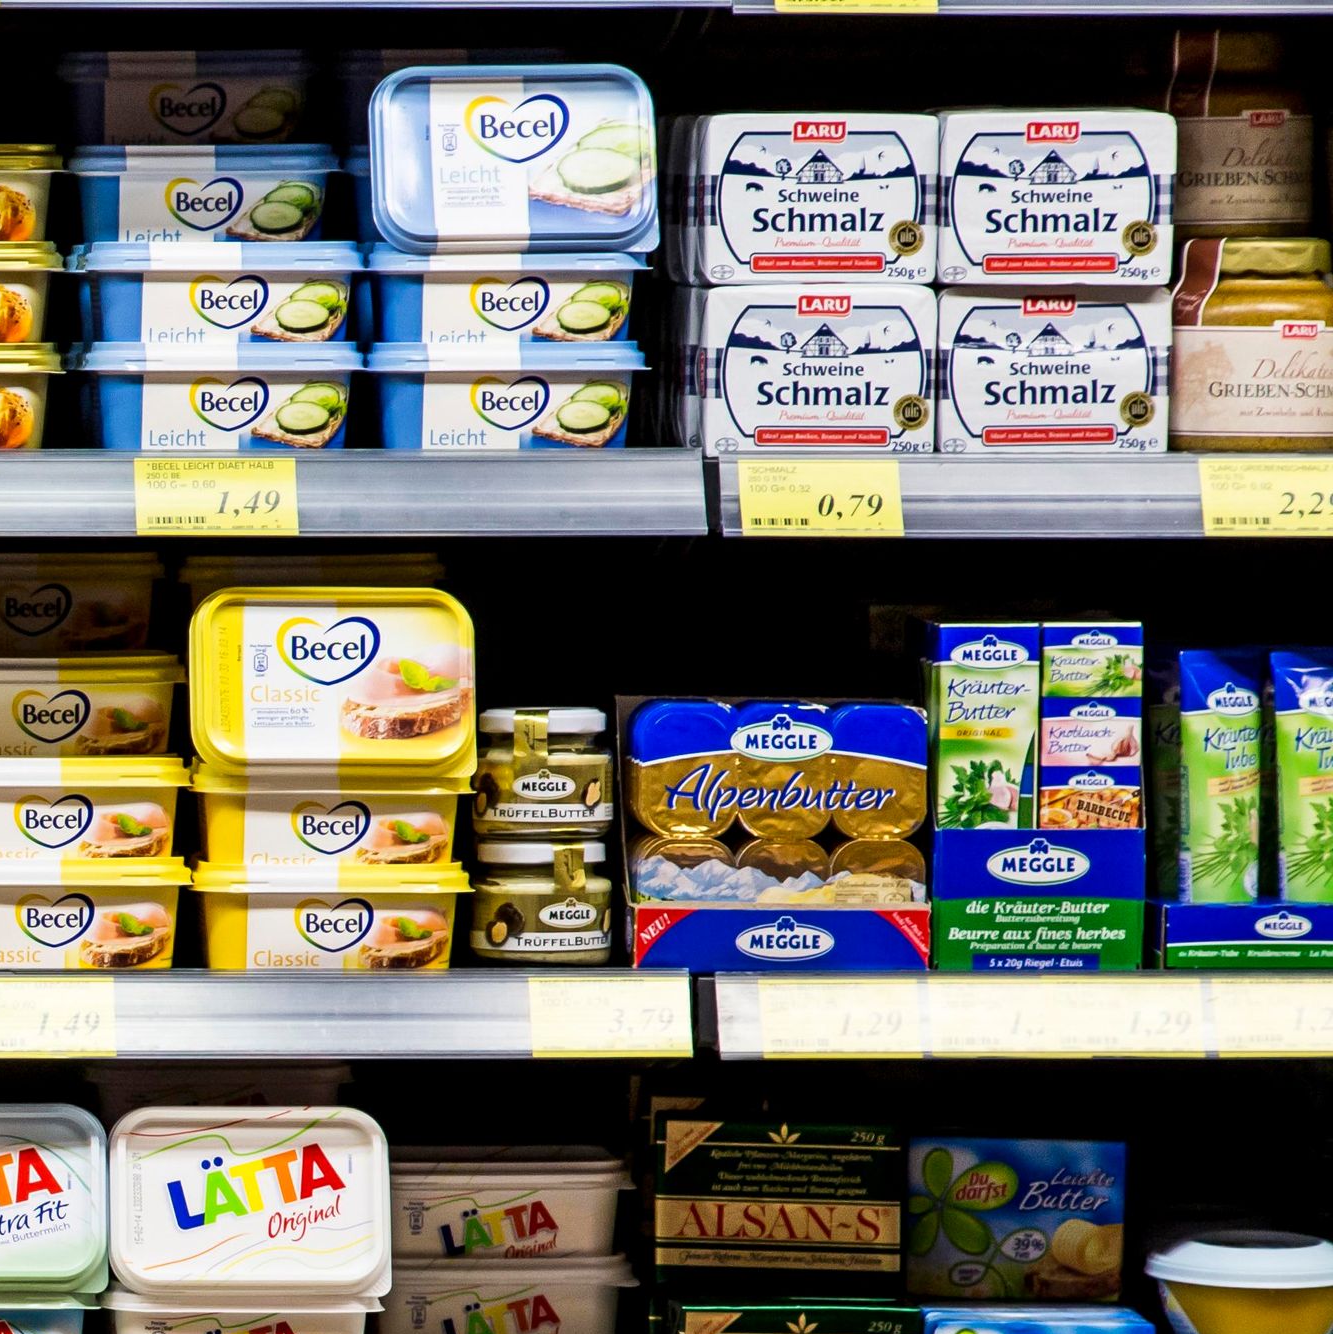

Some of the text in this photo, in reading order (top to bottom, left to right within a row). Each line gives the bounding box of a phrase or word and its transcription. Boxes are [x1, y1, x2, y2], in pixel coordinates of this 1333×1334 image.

[480, 111, 557, 142] Becel
[799, 123, 845, 141] LARU
[778, 188, 858, 205] Schweine
[752, 207, 885, 236] Schmalz
[149, 431, 206, 447] Leicht
[816, 492, 883, 520] 0,79
[291, 637, 368, 660] Becel
[250, 685, 321, 702] Classic
[946, 677, 1031, 698] Kräuter-
[947, 700, 1015, 725] Butter
[743, 733, 818, 752] MEGGLE
[521, 780, 568, 792] MEGGLE
[665, 764, 894, 813] Alpenbutter
[1076, 798, 1131, 823] BARBECUE
[1001, 853, 1076, 874] MEGGLE
[965, 900, 1109, 916] die Kräuter-Butter
[639, 914, 673, 946] NEU!
[947, 925, 1126, 942] Beurre aux fines herbes
[167, 1143, 345, 1230] LÄTTA
[268, 1194, 340, 1240] Original
